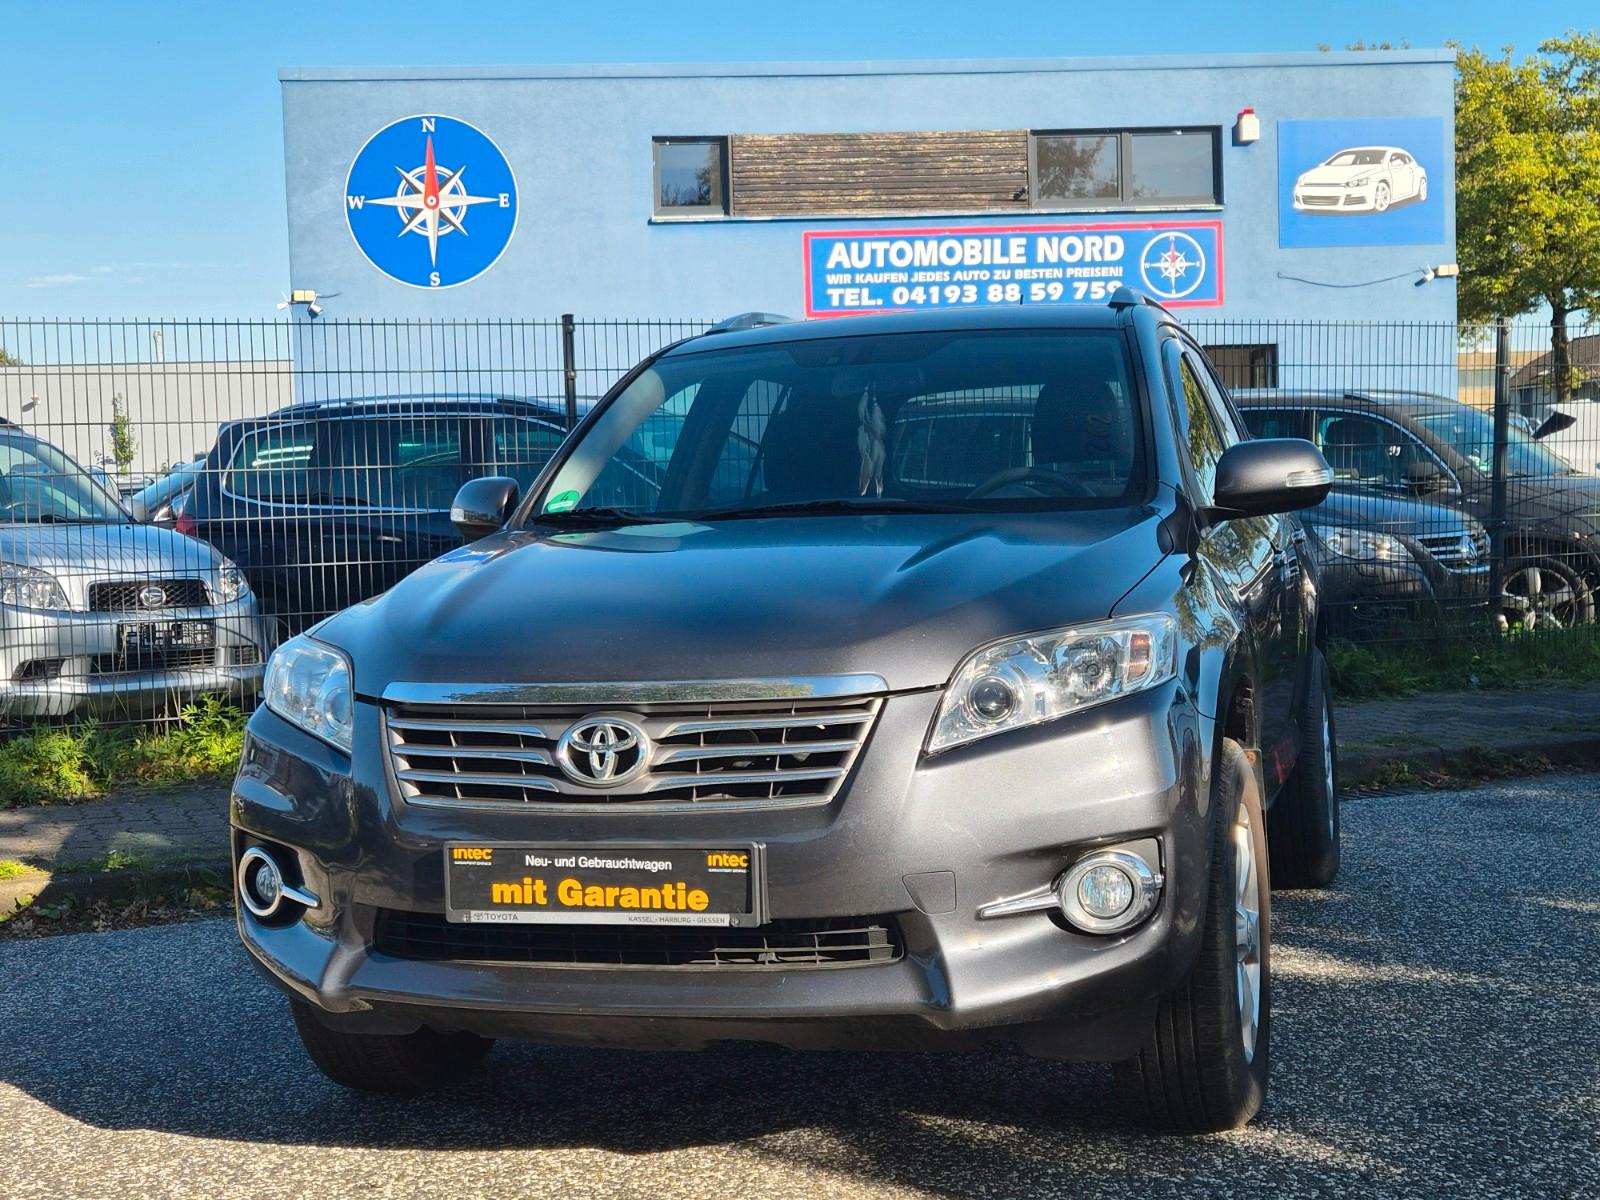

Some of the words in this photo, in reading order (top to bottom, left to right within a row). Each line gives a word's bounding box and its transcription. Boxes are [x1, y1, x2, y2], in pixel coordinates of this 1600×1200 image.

[421, 118, 436, 132] N
[347, 195, 365, 209] W
[498, 193, 510, 208] E
[826, 237, 1027, 269] AUTOMOBILE
[1036, 235, 1125, 264] NORD
[429, 272, 441, 286] S
[826, 274, 852, 285] WIR
[854, 272, 909, 284] KAUFEN
[910, 270, 951, 283] JEDES
[953, 270, 990, 282] AUTO
[993, 269, 1012, 281] ZU
[1014, 268, 1064, 280] BESTEN
[1066, 266, 1124, 279] PREISEN!
[826, 287, 884, 307] TEL.
[892, 285, 978, 305] 04193
[986, 284, 1021, 303] 88
[1030, 282, 1064, 301] 59
[525, 854, 553, 867] Neu-
[554, 857, 576, 868] und
[577, 856, 673, 873] Gebrauchtwagen
[707, 853, 748, 868] intec
[491, 876, 549, 906] mit
[556, 877, 710, 912] Garantie
[485, 913, 519, 921] TOYOTA
[659, 916, 691, 924] MARBURG
